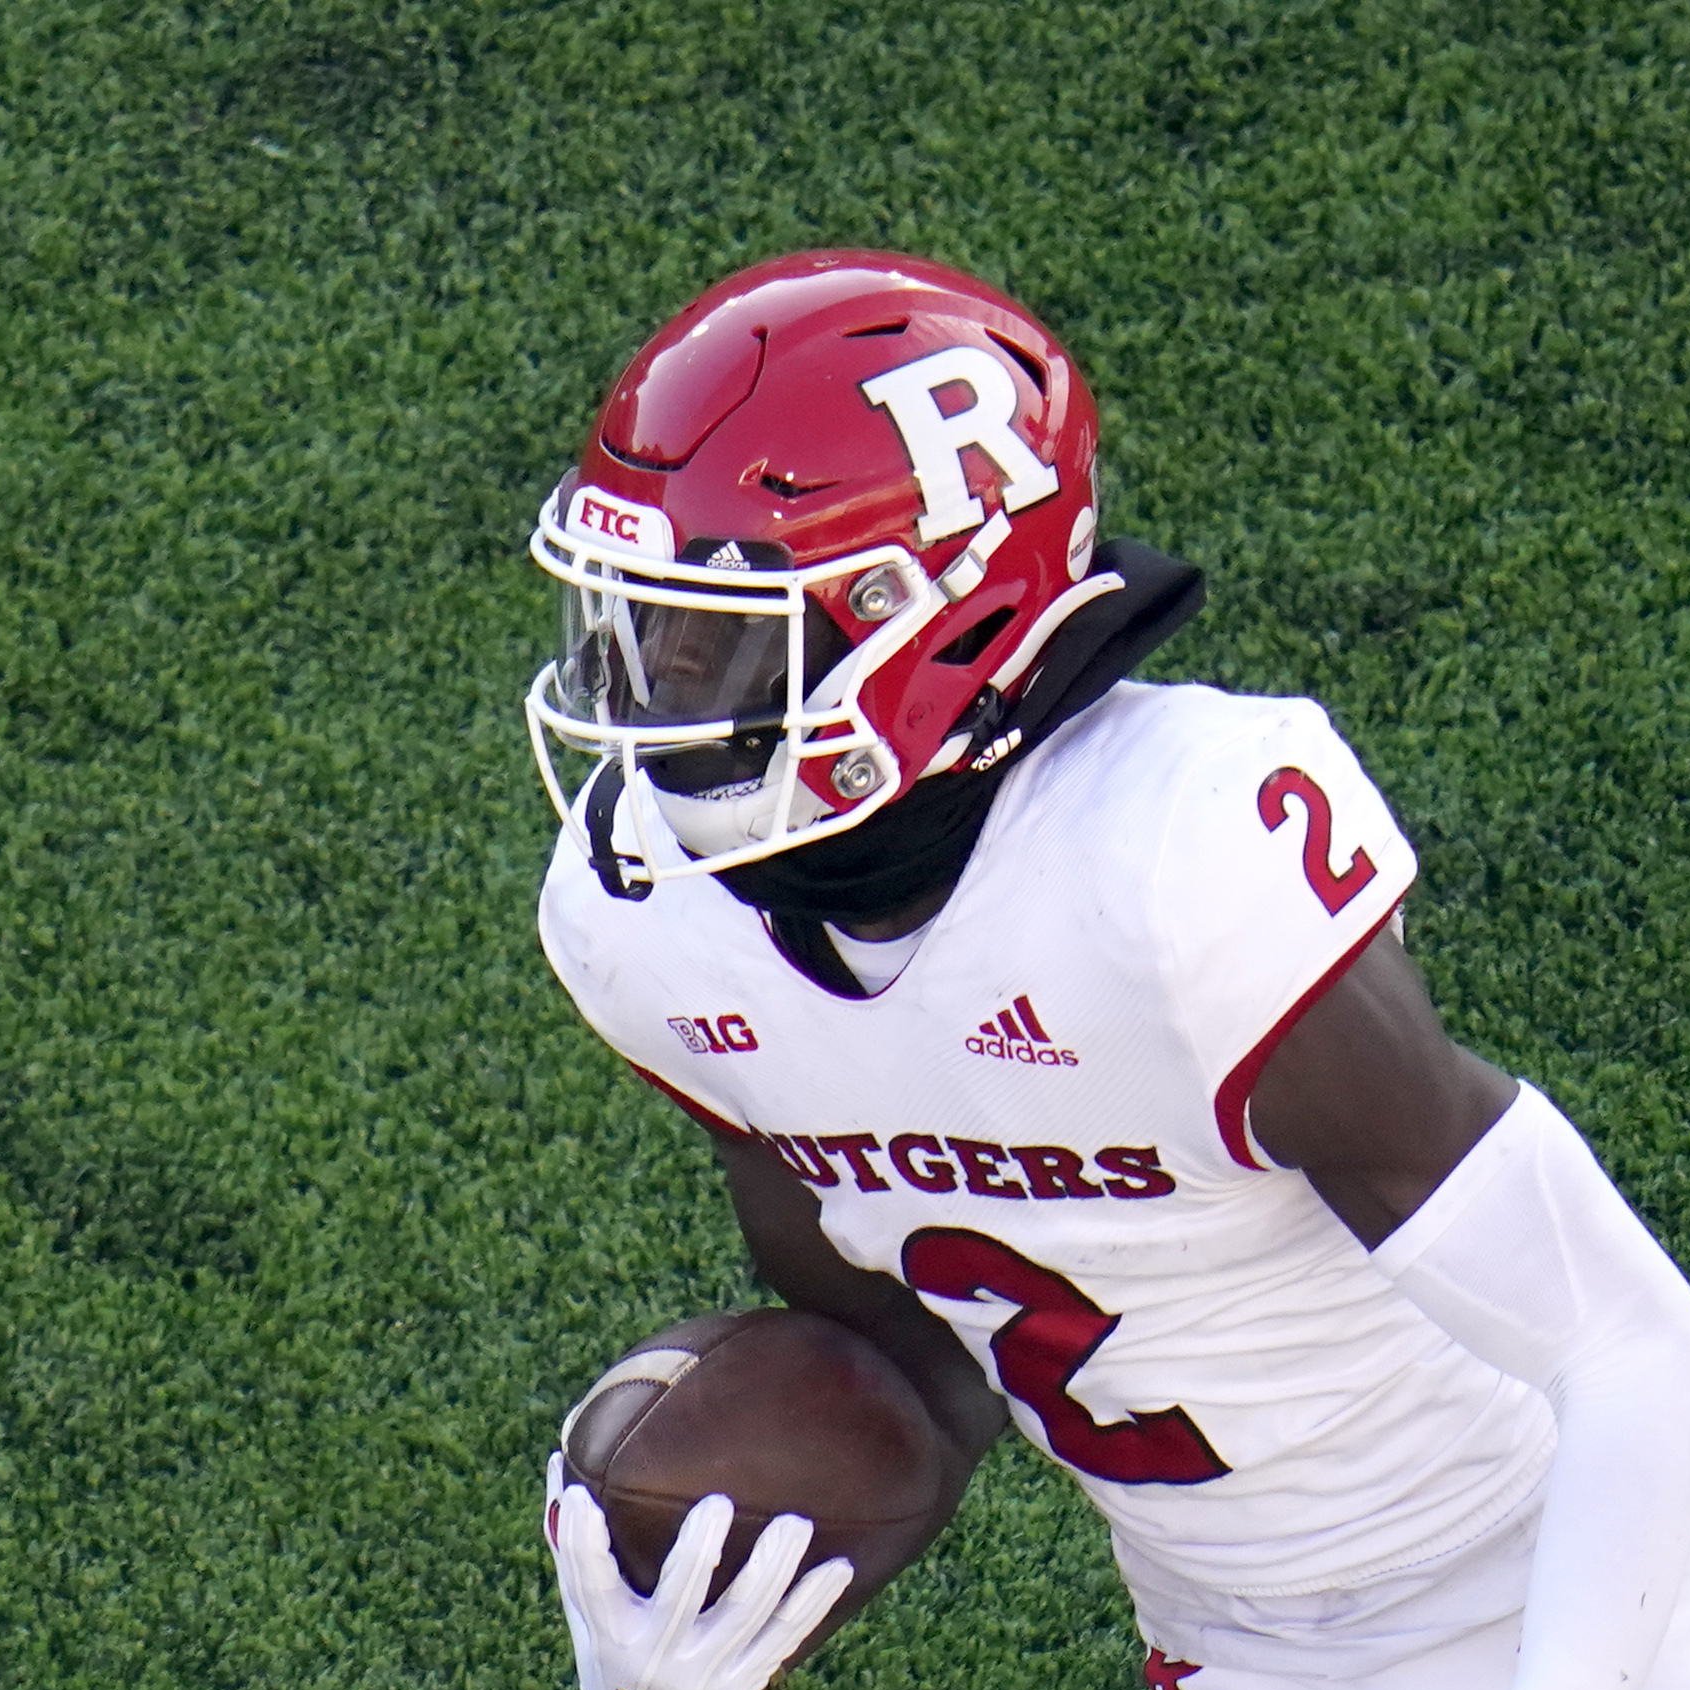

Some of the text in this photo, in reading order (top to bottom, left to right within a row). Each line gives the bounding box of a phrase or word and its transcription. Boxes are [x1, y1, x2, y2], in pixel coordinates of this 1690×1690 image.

[859, 345, 1061, 545] R
[580, 497, 640, 544] FTC
[706, 558, 751, 571] adidas
[1256, 765, 1378, 918] 2
[965, 1034, 1080, 1067] adidas
[766, 1130, 1177, 1200] UTGERS
[901, 1225, 1234, 1485] 2
